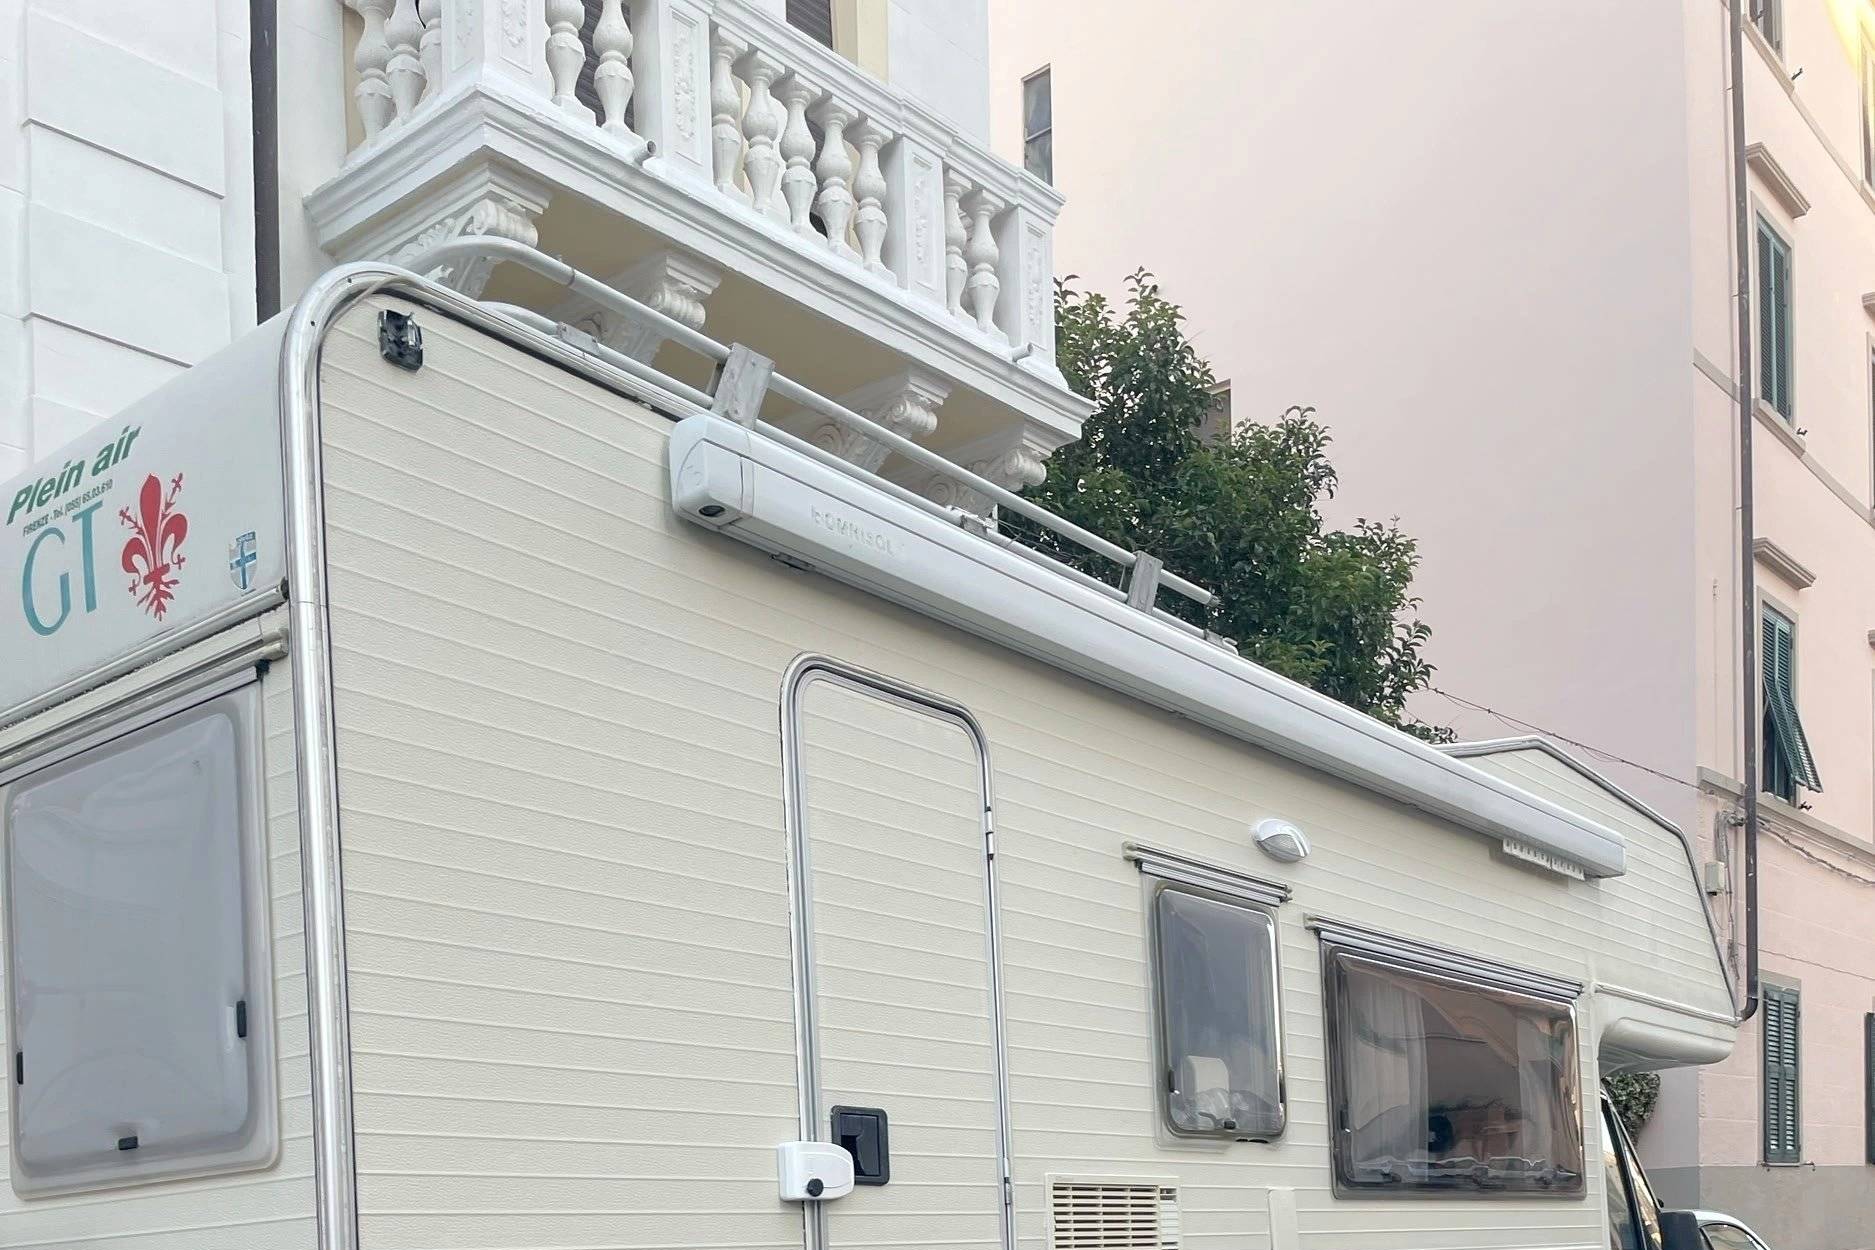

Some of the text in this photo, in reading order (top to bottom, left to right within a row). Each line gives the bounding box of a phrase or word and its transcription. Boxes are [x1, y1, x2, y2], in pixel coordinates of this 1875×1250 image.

[6, 425, 142, 526] Plein air
[22, 500, 104, 637] GT
